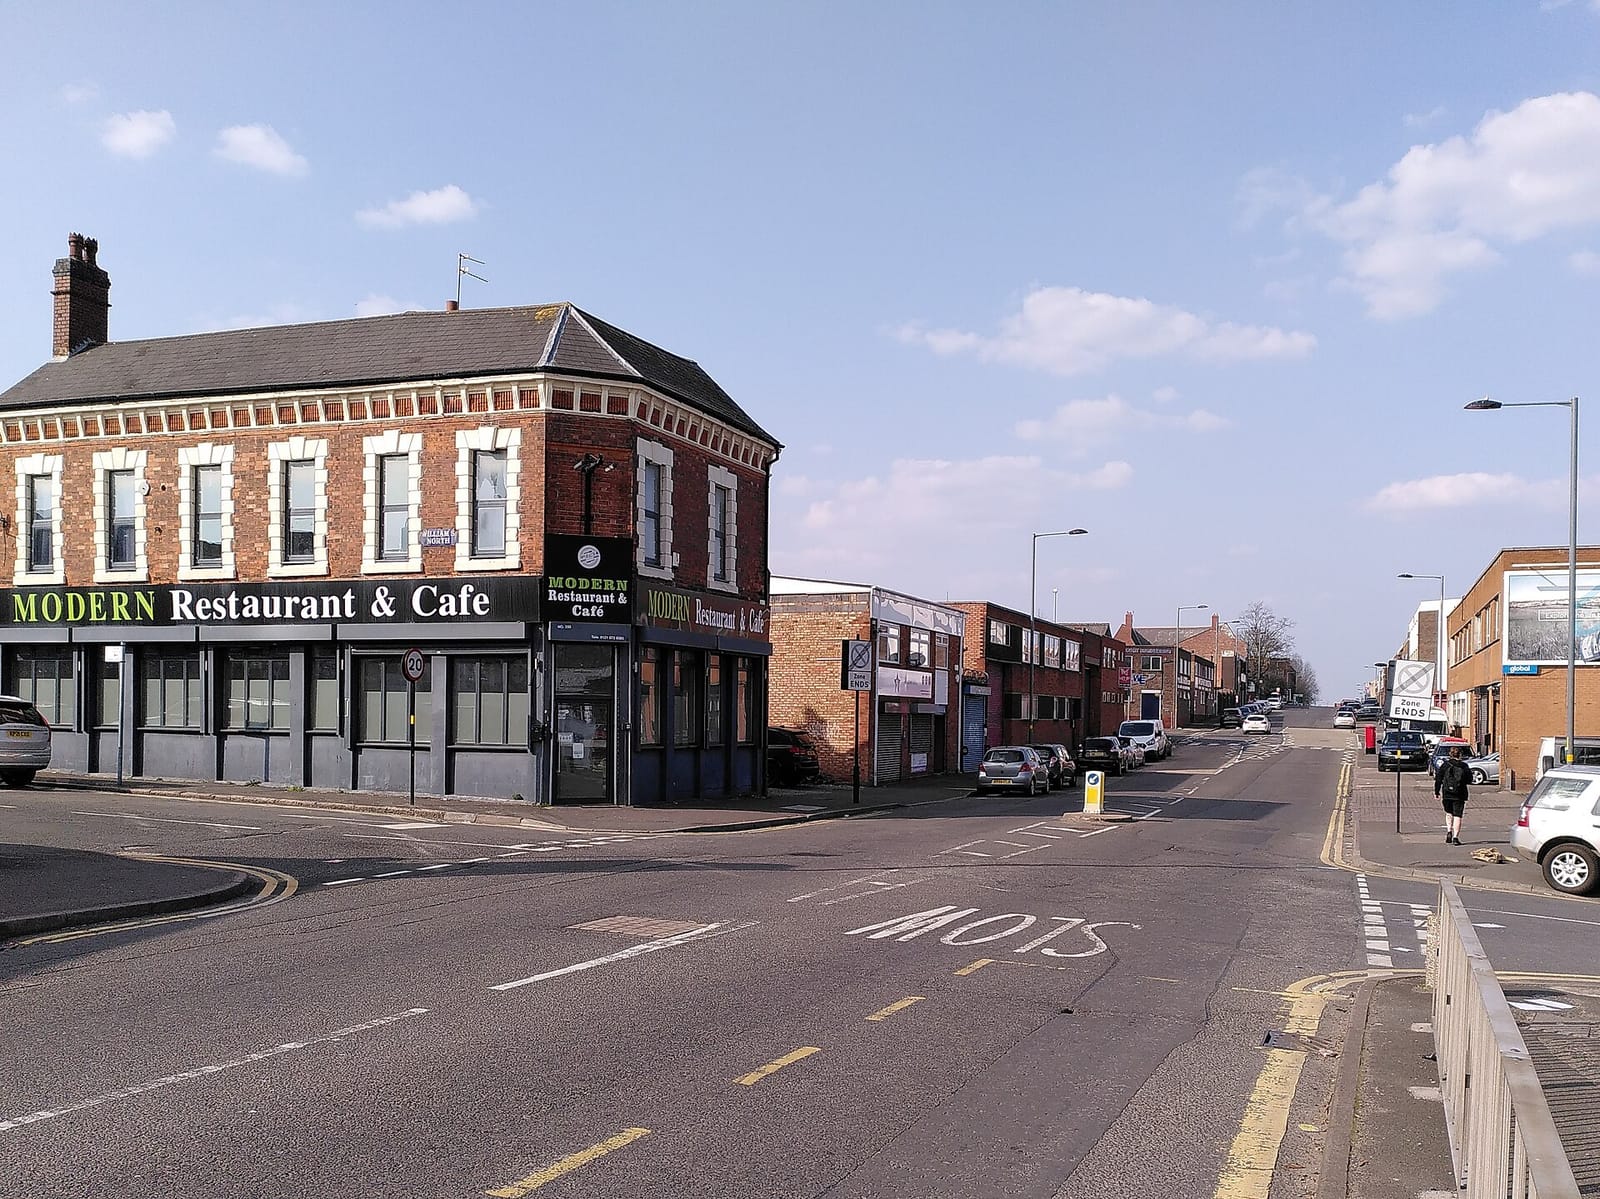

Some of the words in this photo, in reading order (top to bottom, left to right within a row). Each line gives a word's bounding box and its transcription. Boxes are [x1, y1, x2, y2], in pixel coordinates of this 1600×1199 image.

[426, 537, 450, 545] NORTH
[548, 576, 628, 591] MODERN
[548, 589, 615, 604] Restaurant
[618, 592, 628, 604] &
[12, 591, 155, 623] MODERN
[169, 588, 356, 620] Restaurant
[371, 585, 396, 617] &
[411, 584, 490, 617] Cafe
[572, 604, 604, 617] Café
[648, 589, 690, 622] MODERN
[695, 598, 736, 630] Restaurant
[740, 607, 746, 632] &
[408, 657, 421, 671] 20
[1509, 664, 1531, 674] global
[850, 680, 869, 688] ENDS
[1401, 699, 1421, 707] Zone
[1394, 707, 1425, 717] ENDS
[844, 905, 1142, 958] SLOW
